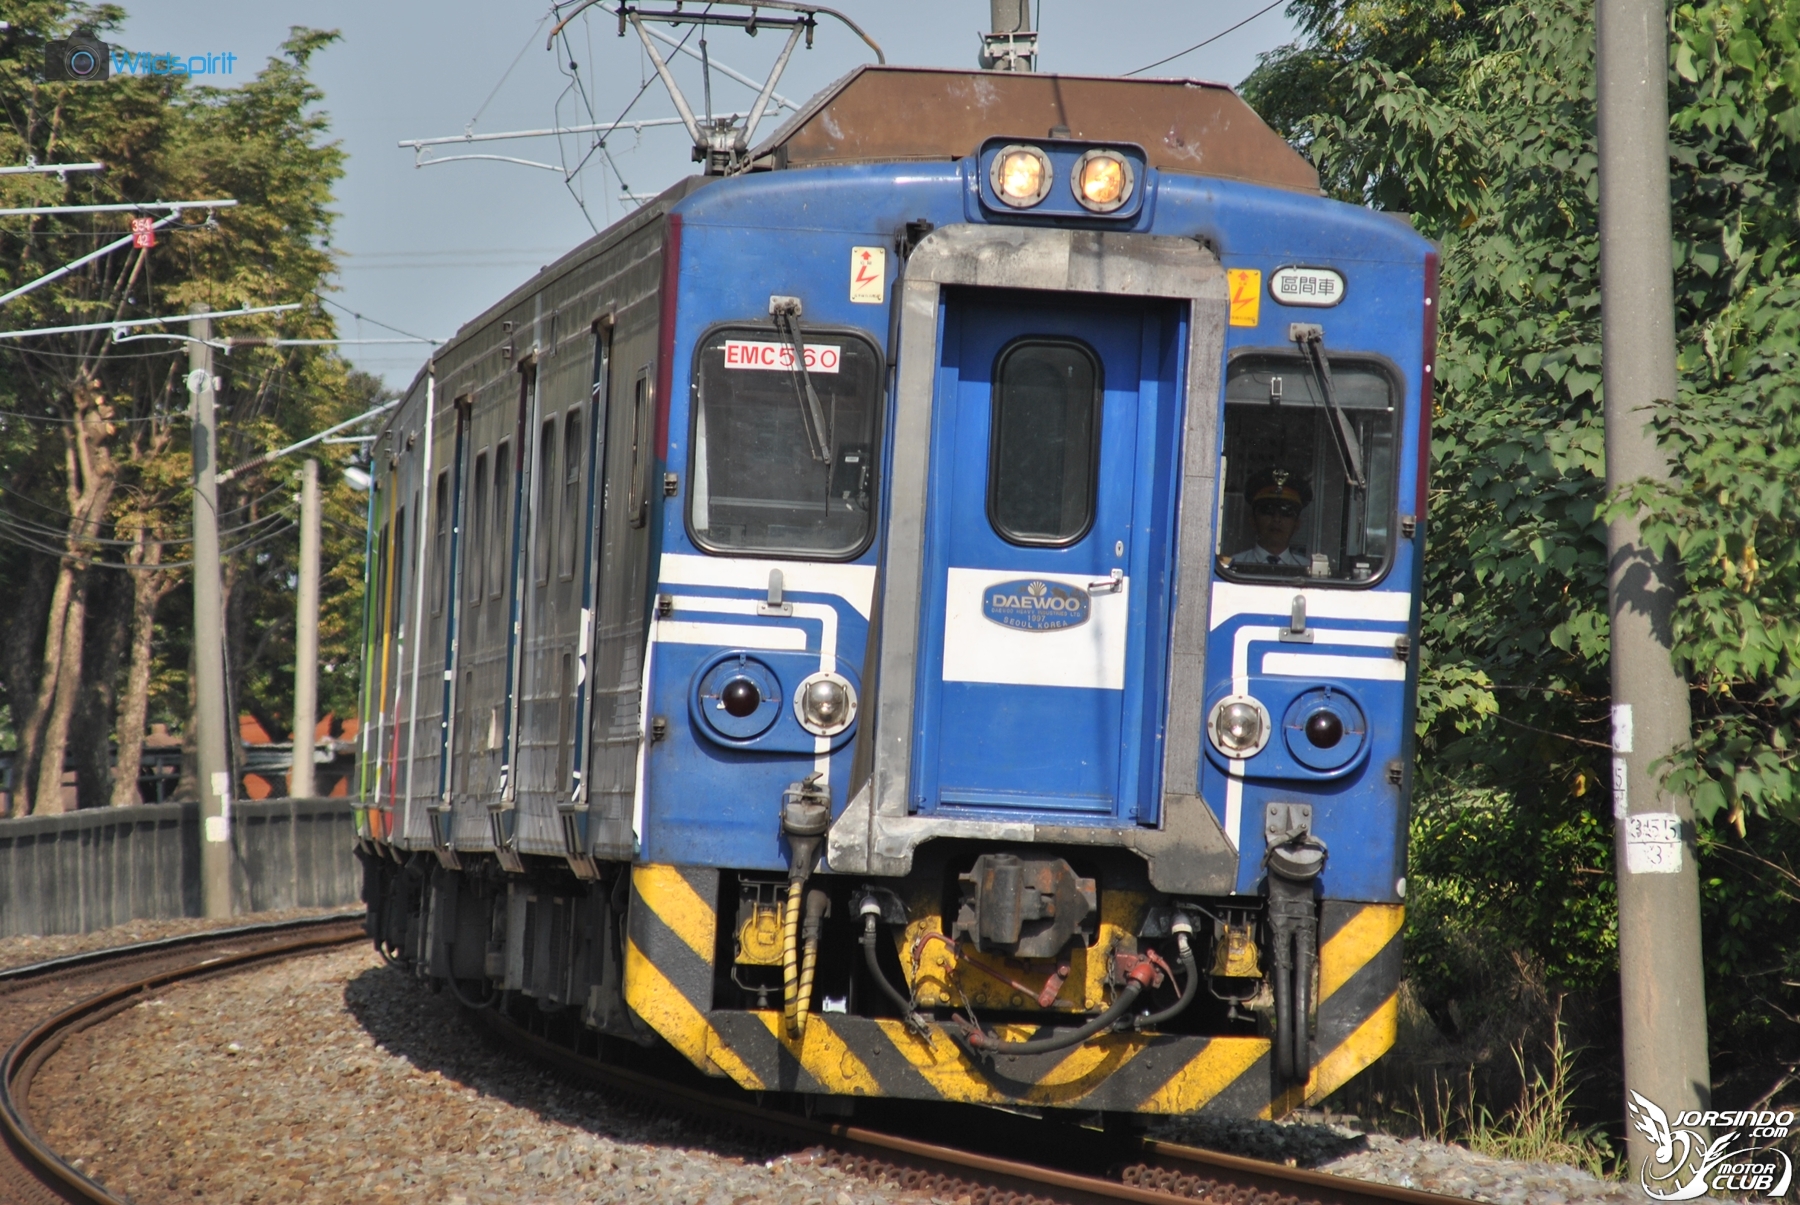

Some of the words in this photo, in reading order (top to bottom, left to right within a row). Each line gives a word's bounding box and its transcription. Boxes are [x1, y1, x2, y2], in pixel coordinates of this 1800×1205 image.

[132, 219, 151, 232] 354
[136, 234, 149, 247] 42
[1281, 275, 1335, 296] 區間車
[992, 594, 1080, 611] DAEWOO
[1003, 616, 1033, 629] SEOUL
[1037, 620, 1068, 629] KOREA
